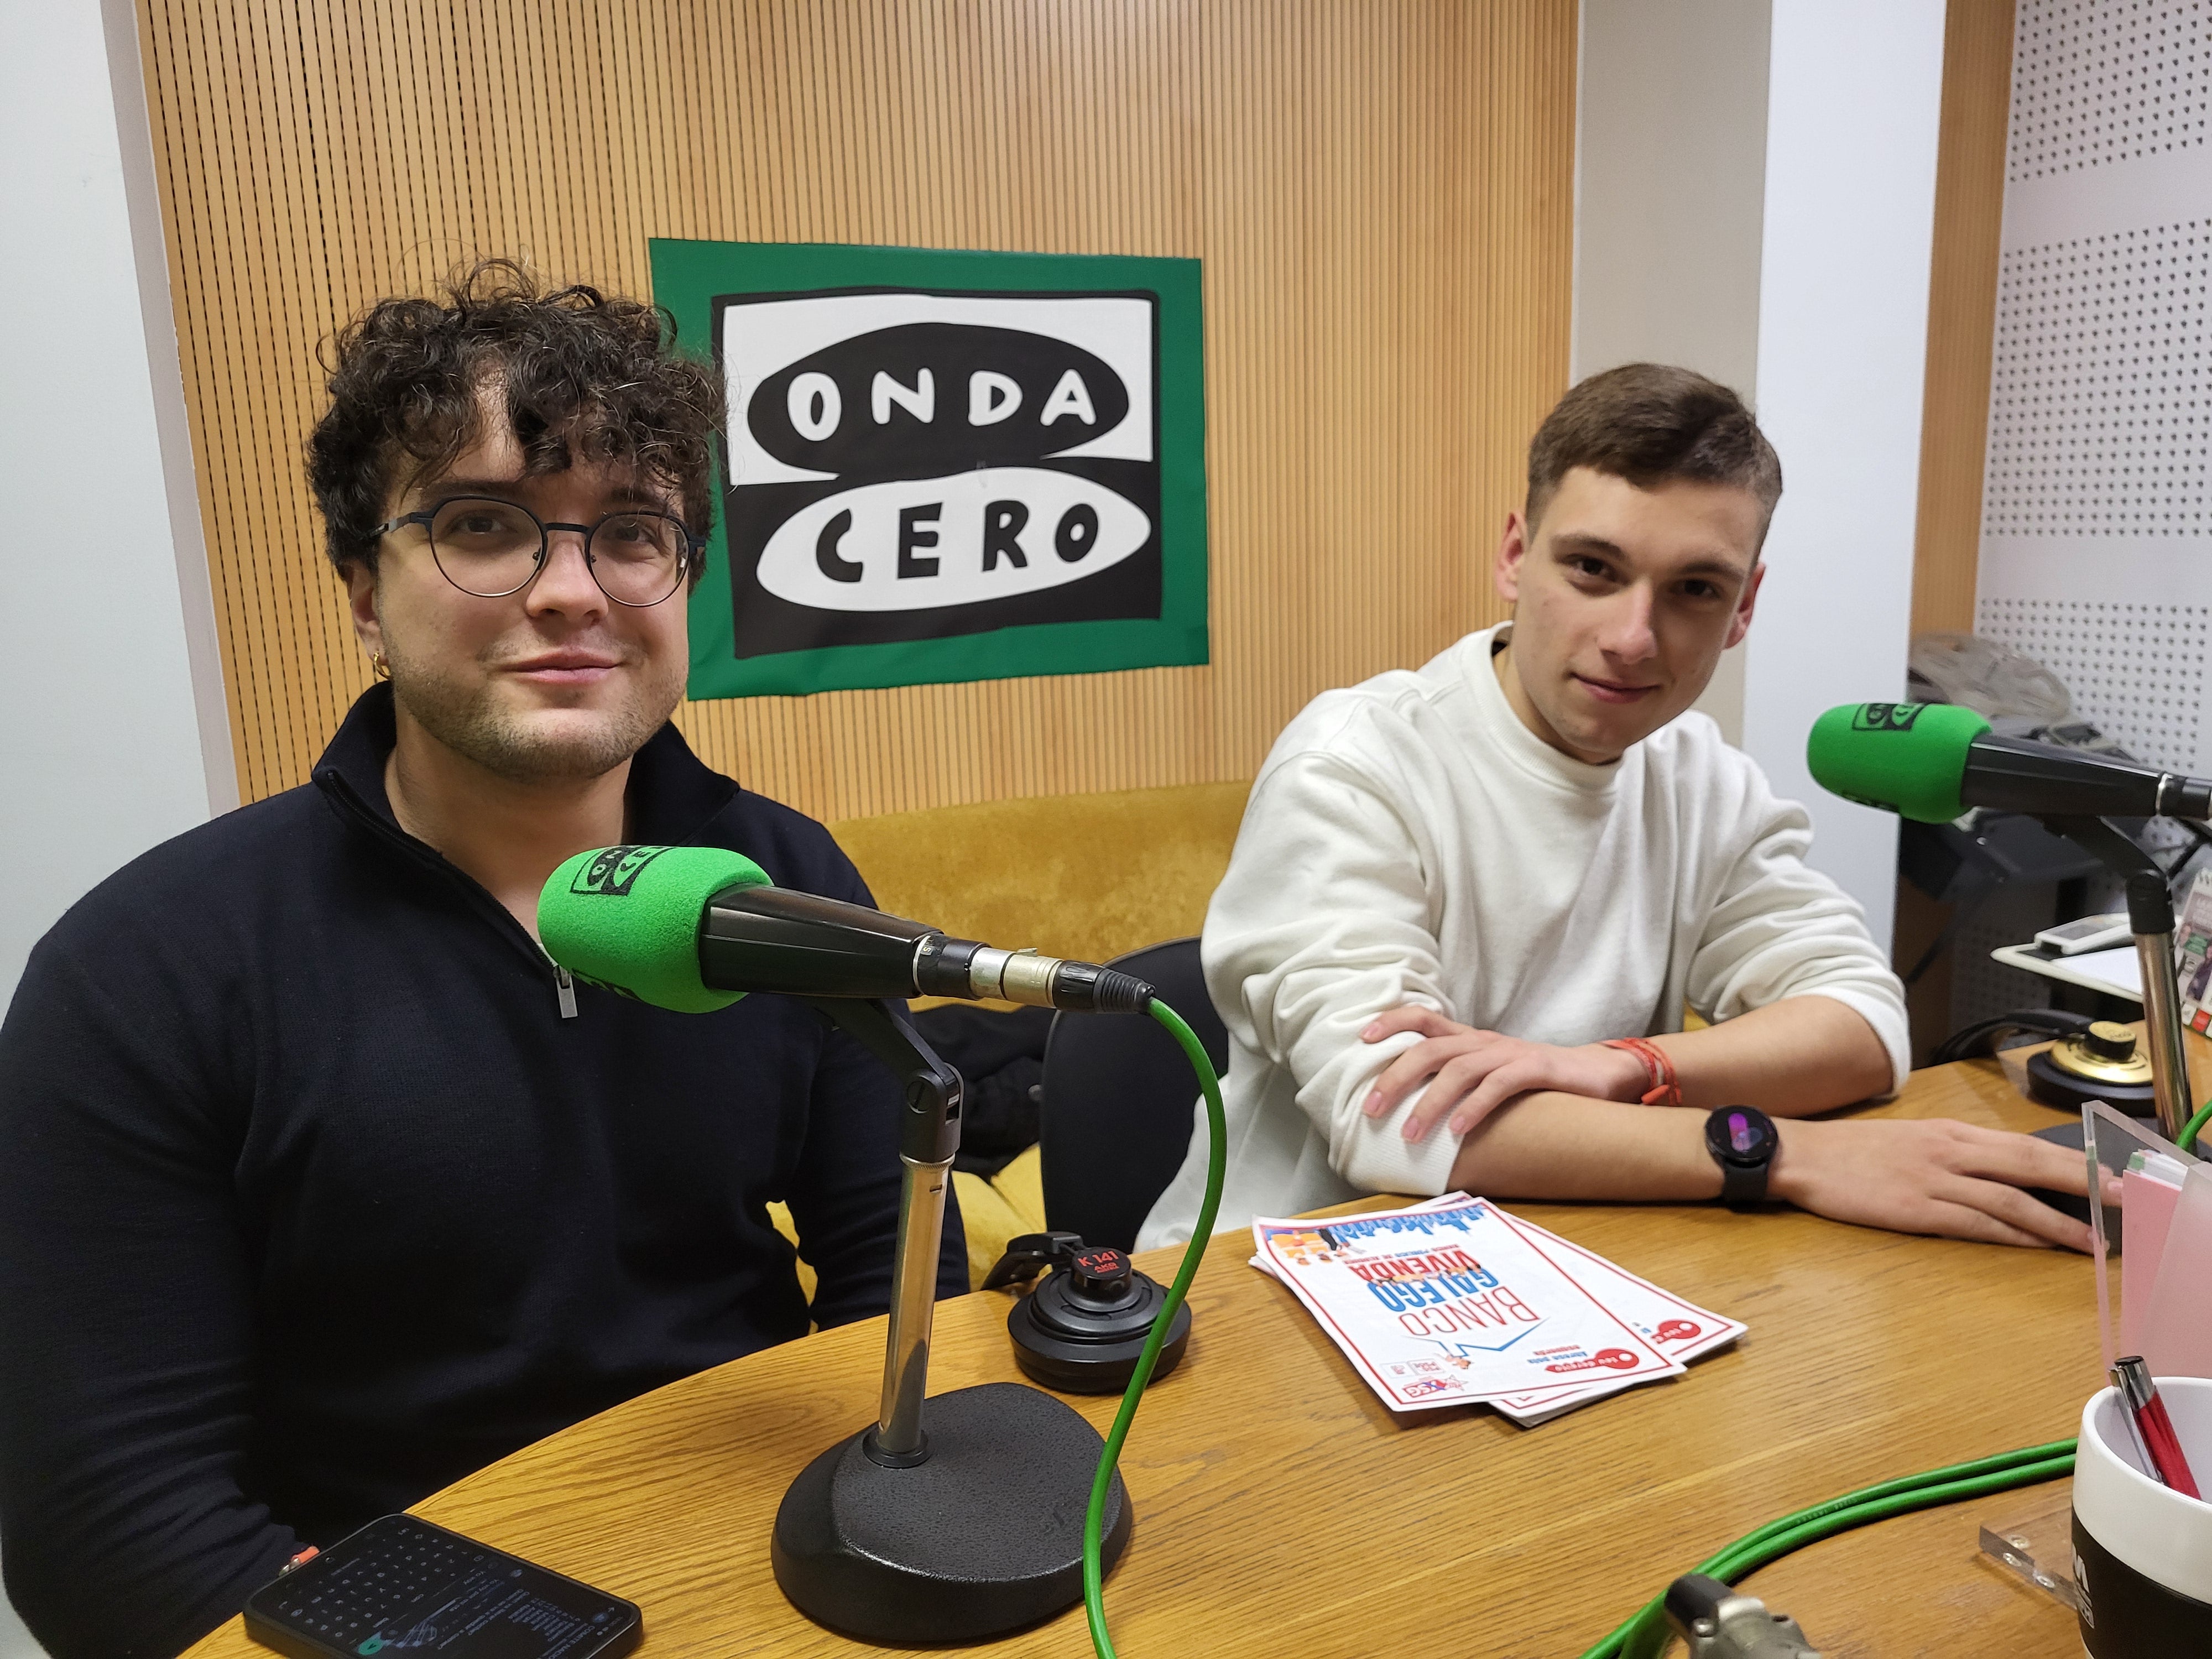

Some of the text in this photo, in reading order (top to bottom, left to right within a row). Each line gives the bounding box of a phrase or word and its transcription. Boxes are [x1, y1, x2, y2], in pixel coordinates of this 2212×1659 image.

[787, 367, 1097, 441] ONDA
[816, 499, 1099, 583] CERO
[1077, 1251, 1119, 1267] K 141
[1348, 1250, 1481, 1282] VIVENDA
[1399, 1286, 1540, 1336] BANCO
